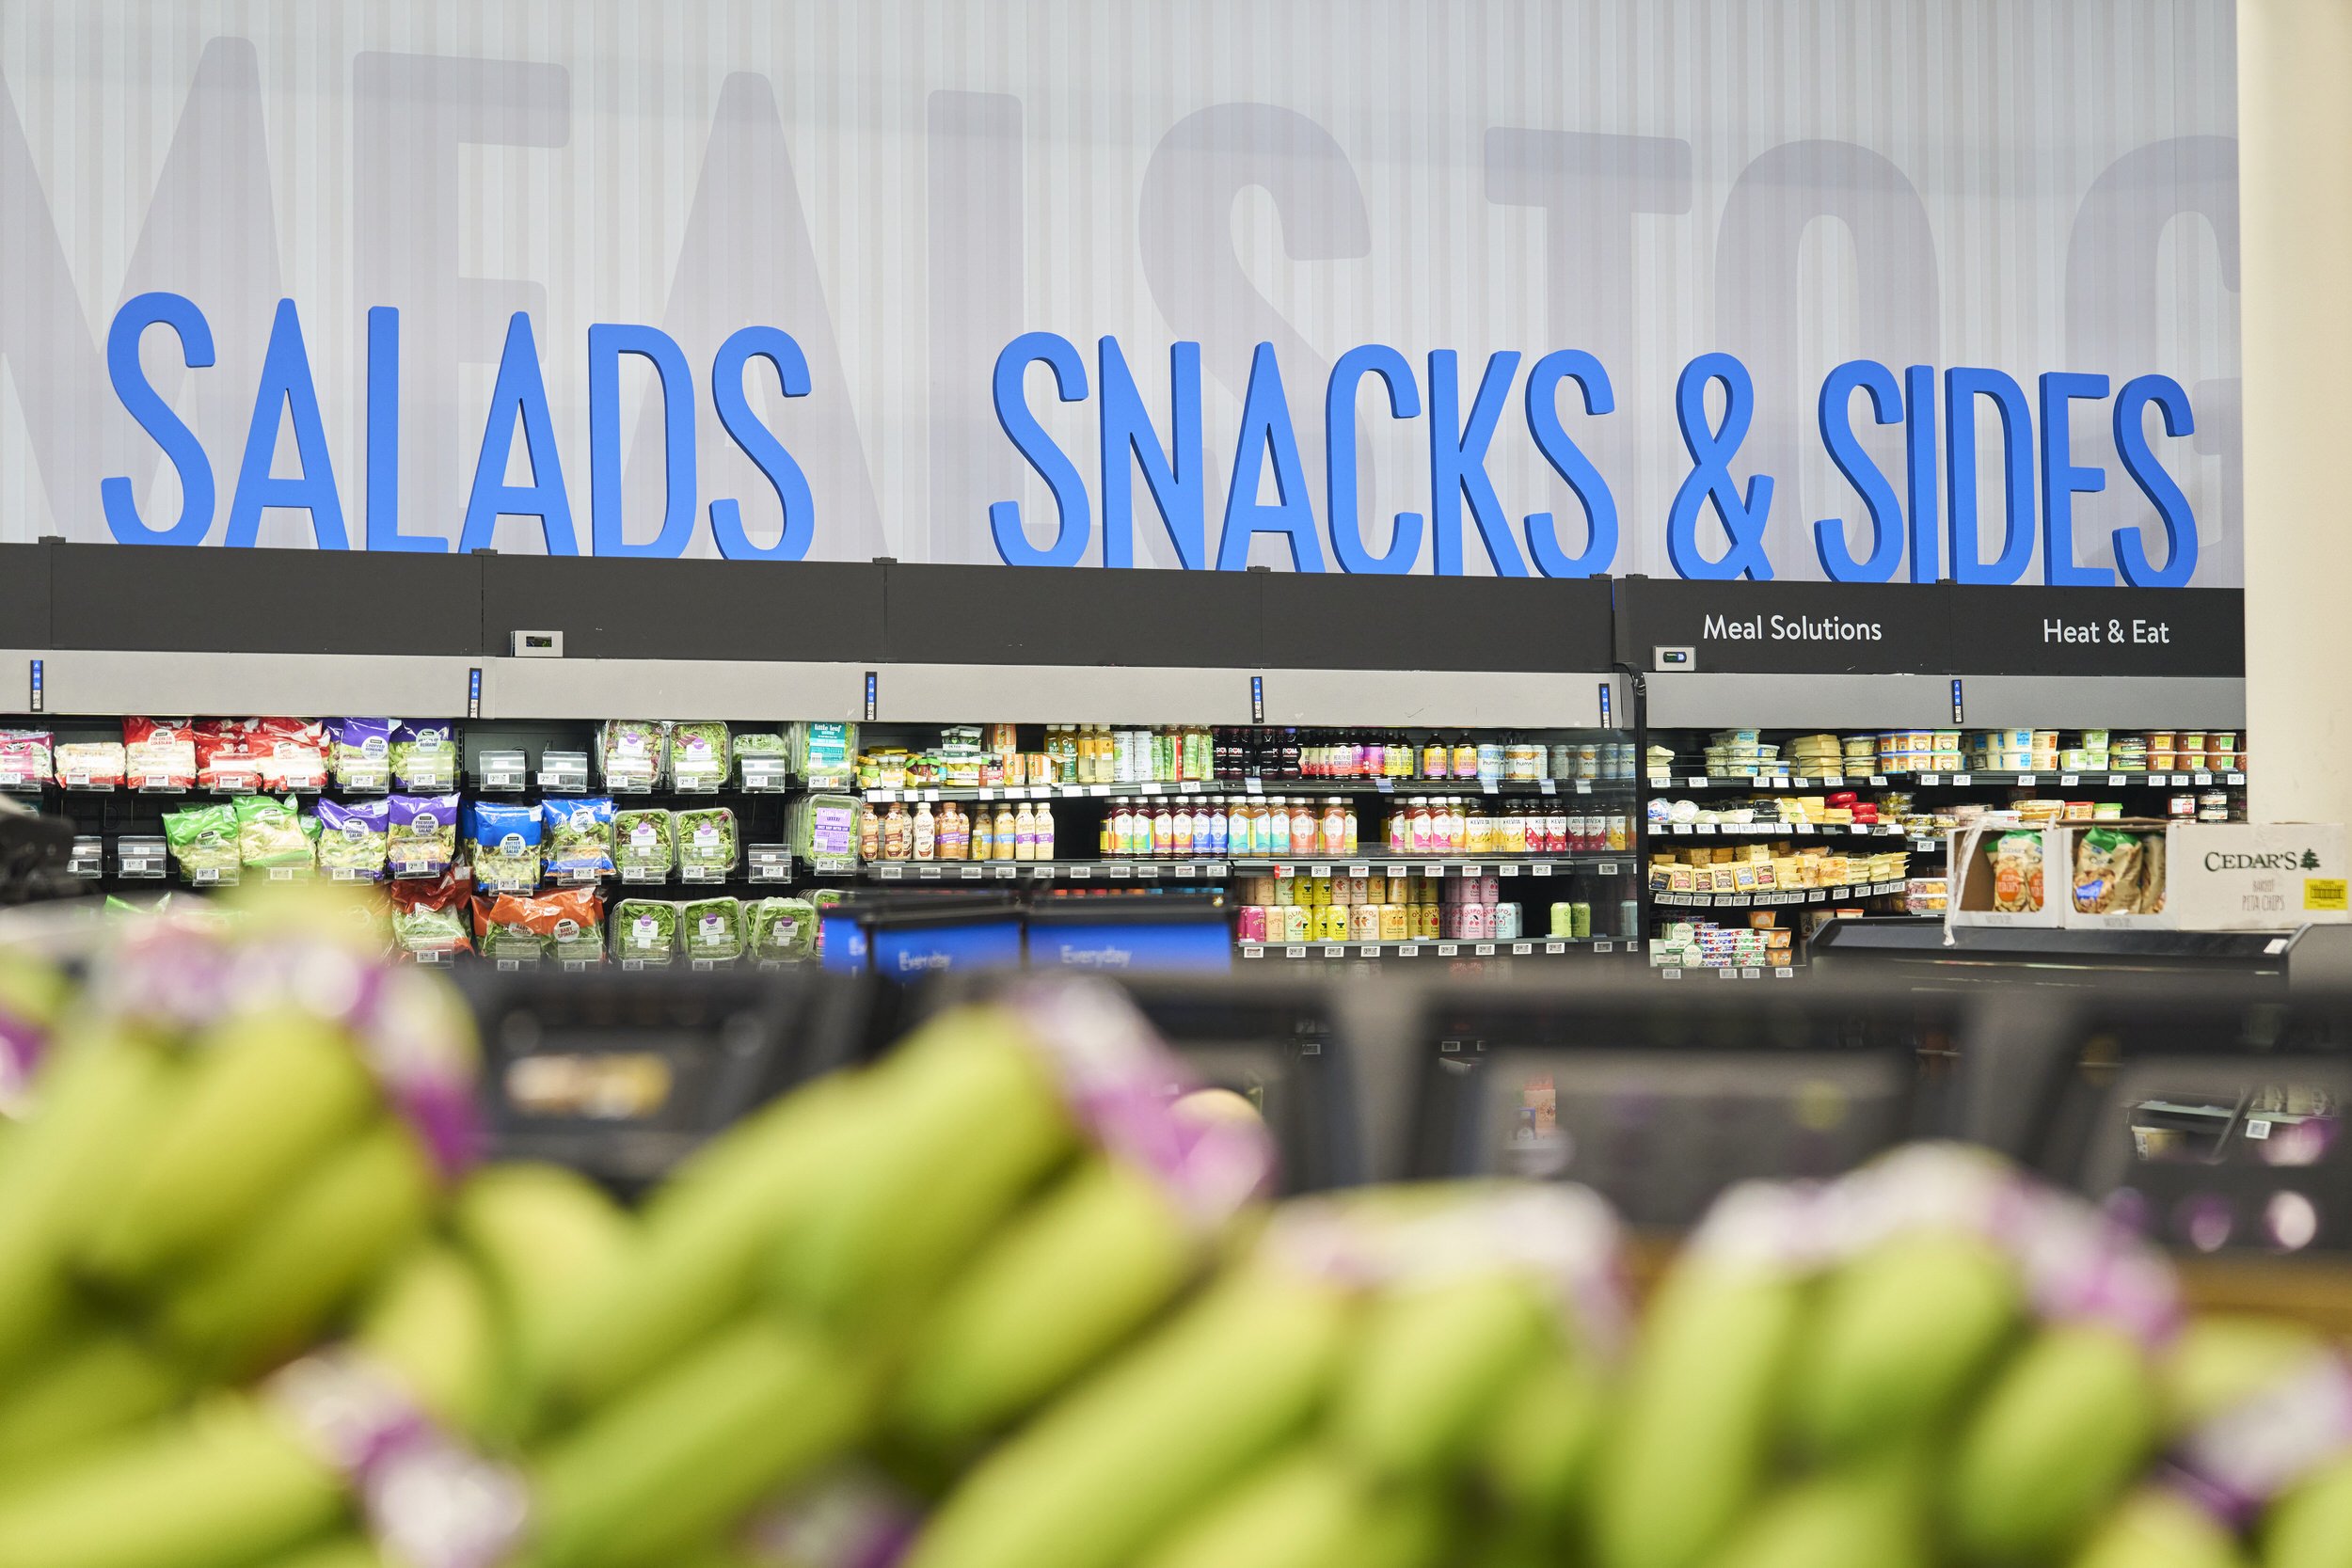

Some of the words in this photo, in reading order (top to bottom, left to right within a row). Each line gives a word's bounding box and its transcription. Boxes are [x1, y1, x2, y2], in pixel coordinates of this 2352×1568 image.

[101, 292, 816, 562] SALADS
[990, 331, 1619, 580] SNACKS
[1666, 352, 1775, 582] &
[1814, 358, 2199, 589] SIDES
[1702, 614, 1763, 641] Meal
[1771, 614, 1883, 642] Solutions
[2042, 618, 2100, 644] Heat
[2107, 620, 2126, 644] &
[2132, 620, 2170, 644] Eat
[2204, 851, 2297, 872] CEDAR'S
[2242, 895, 2260, 911] PITA
[2262, 895, 2286, 911] CHIPS
[557, 930, 578, 939] SPINACH
[1059, 943, 1132, 968] Everyday
